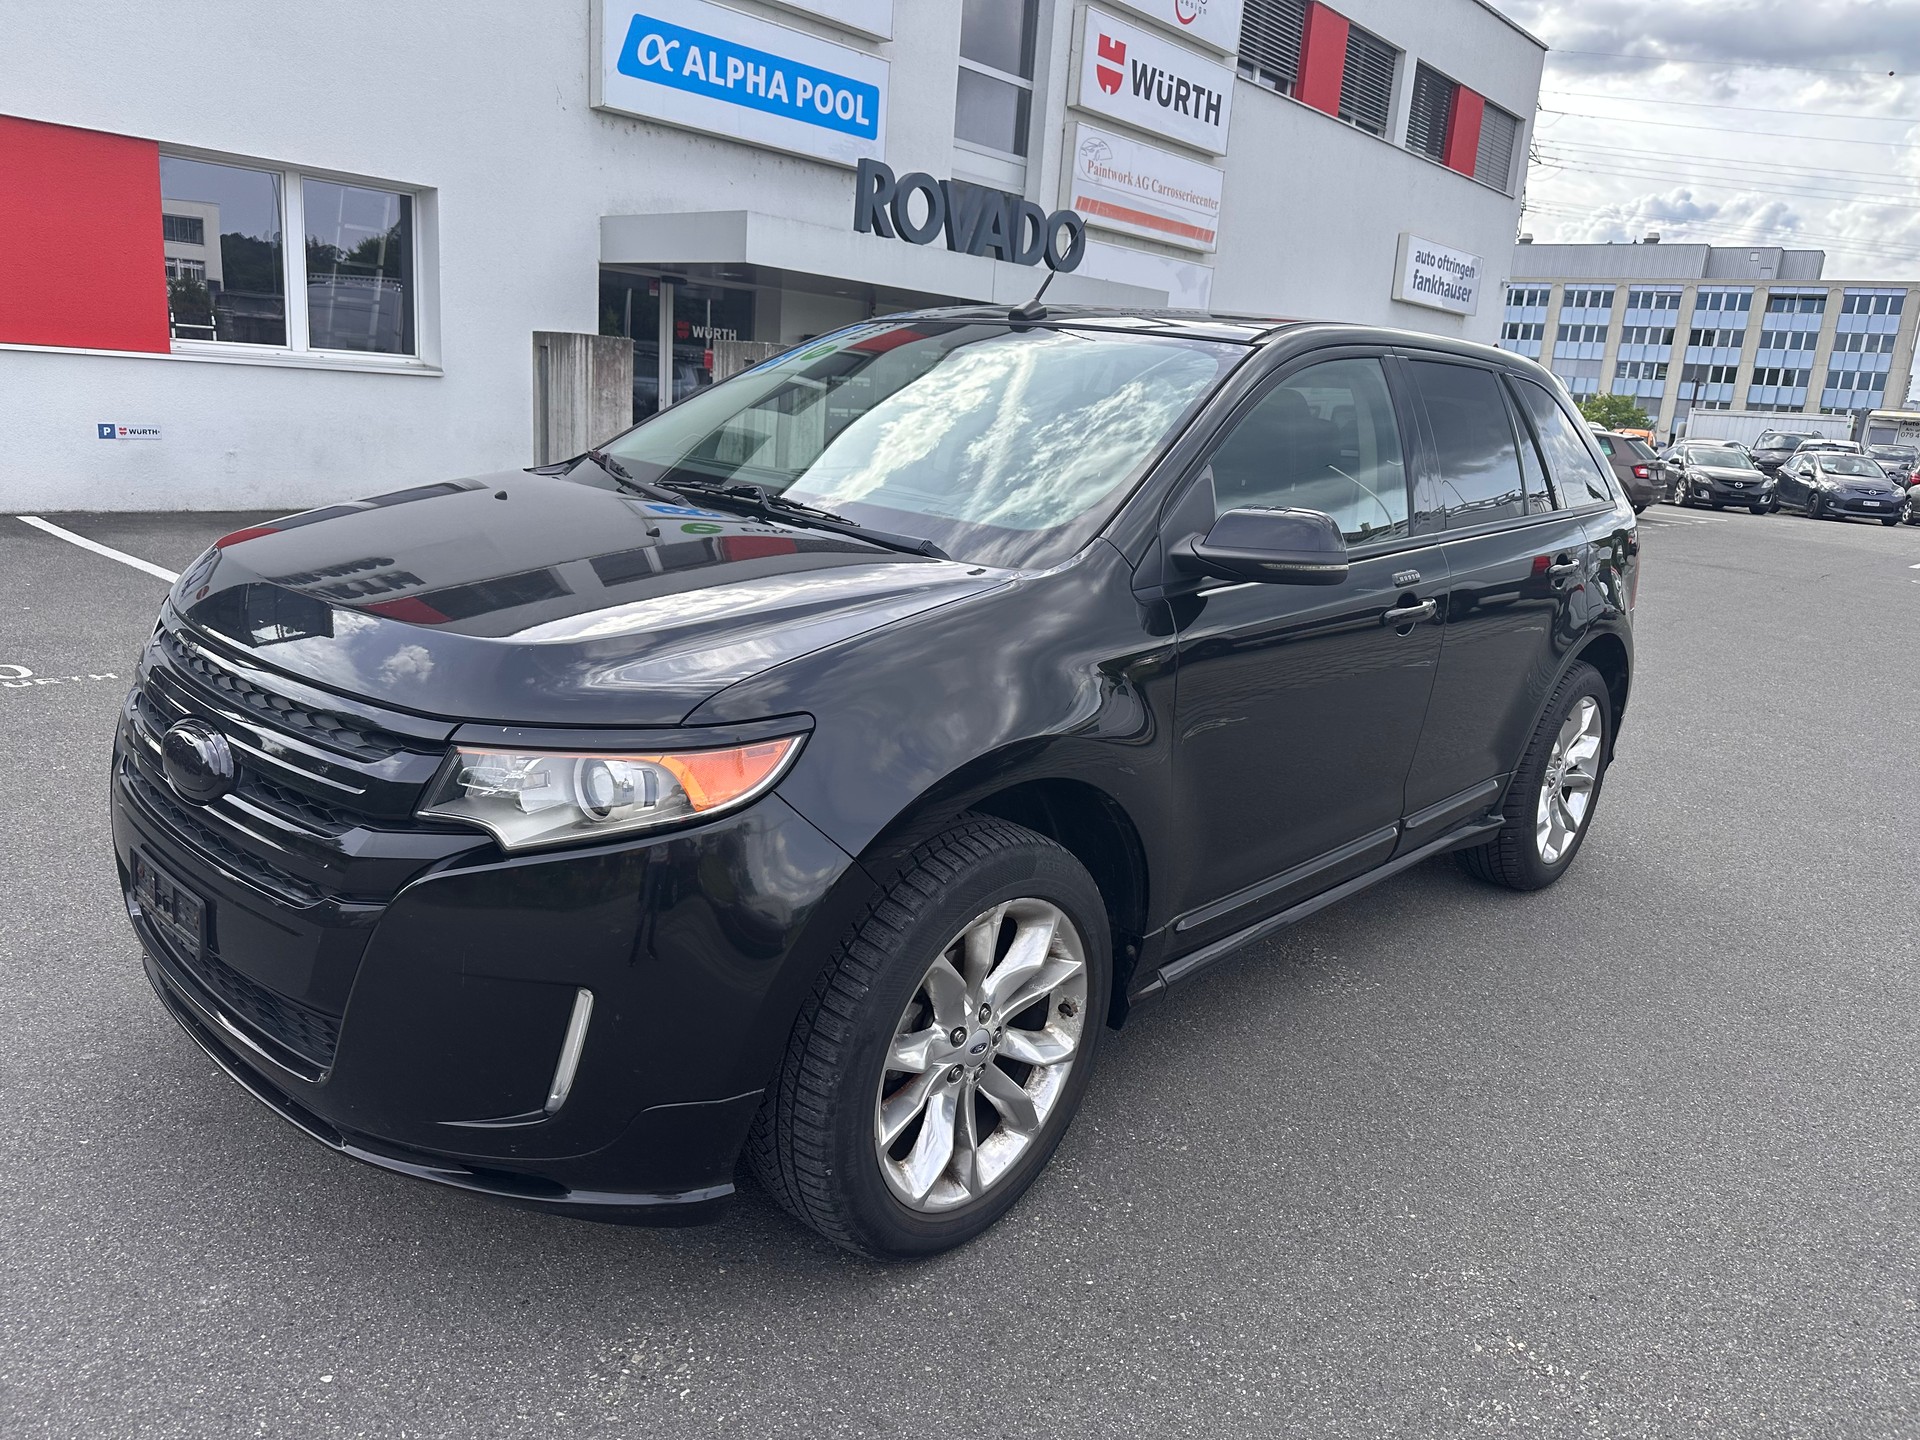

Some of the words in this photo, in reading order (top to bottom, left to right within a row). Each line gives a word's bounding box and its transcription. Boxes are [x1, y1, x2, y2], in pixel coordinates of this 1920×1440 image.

[682, 45, 789, 104] ALPHA
[796, 76, 870, 126] POOL
[1087, 159, 1133, 186] Paintwork
[1134, 174, 1150, 191] AG
[853, 158, 1086, 274] ROVADO
[1415, 250, 1436, 267] auto
[1437, 255, 1474, 280] oftringen
[1413, 269, 1472, 302] fankhauser
[103, 426, 111, 436] P
